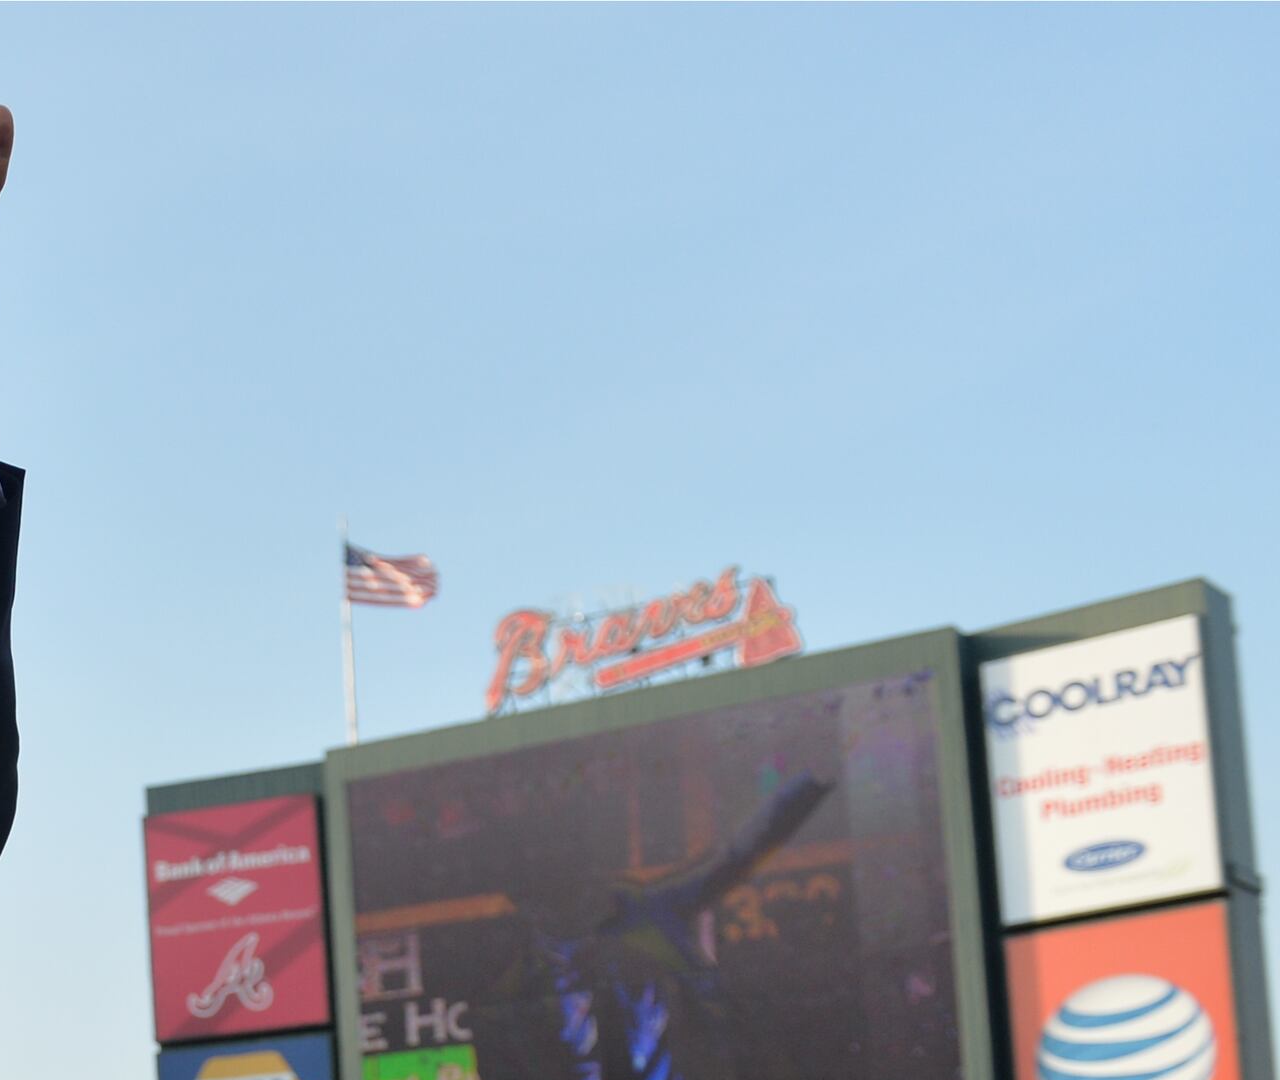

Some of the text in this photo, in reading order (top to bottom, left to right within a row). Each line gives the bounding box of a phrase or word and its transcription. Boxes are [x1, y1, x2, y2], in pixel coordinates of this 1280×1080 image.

[485, 565, 741, 712] Braves
[989, 655, 1202, 728] COOLRAY
[996, 742, 1205, 797] Cooling Heating
[1042, 785, 1162, 820] Plumbing
[154, 845, 311, 882] Bank of America
